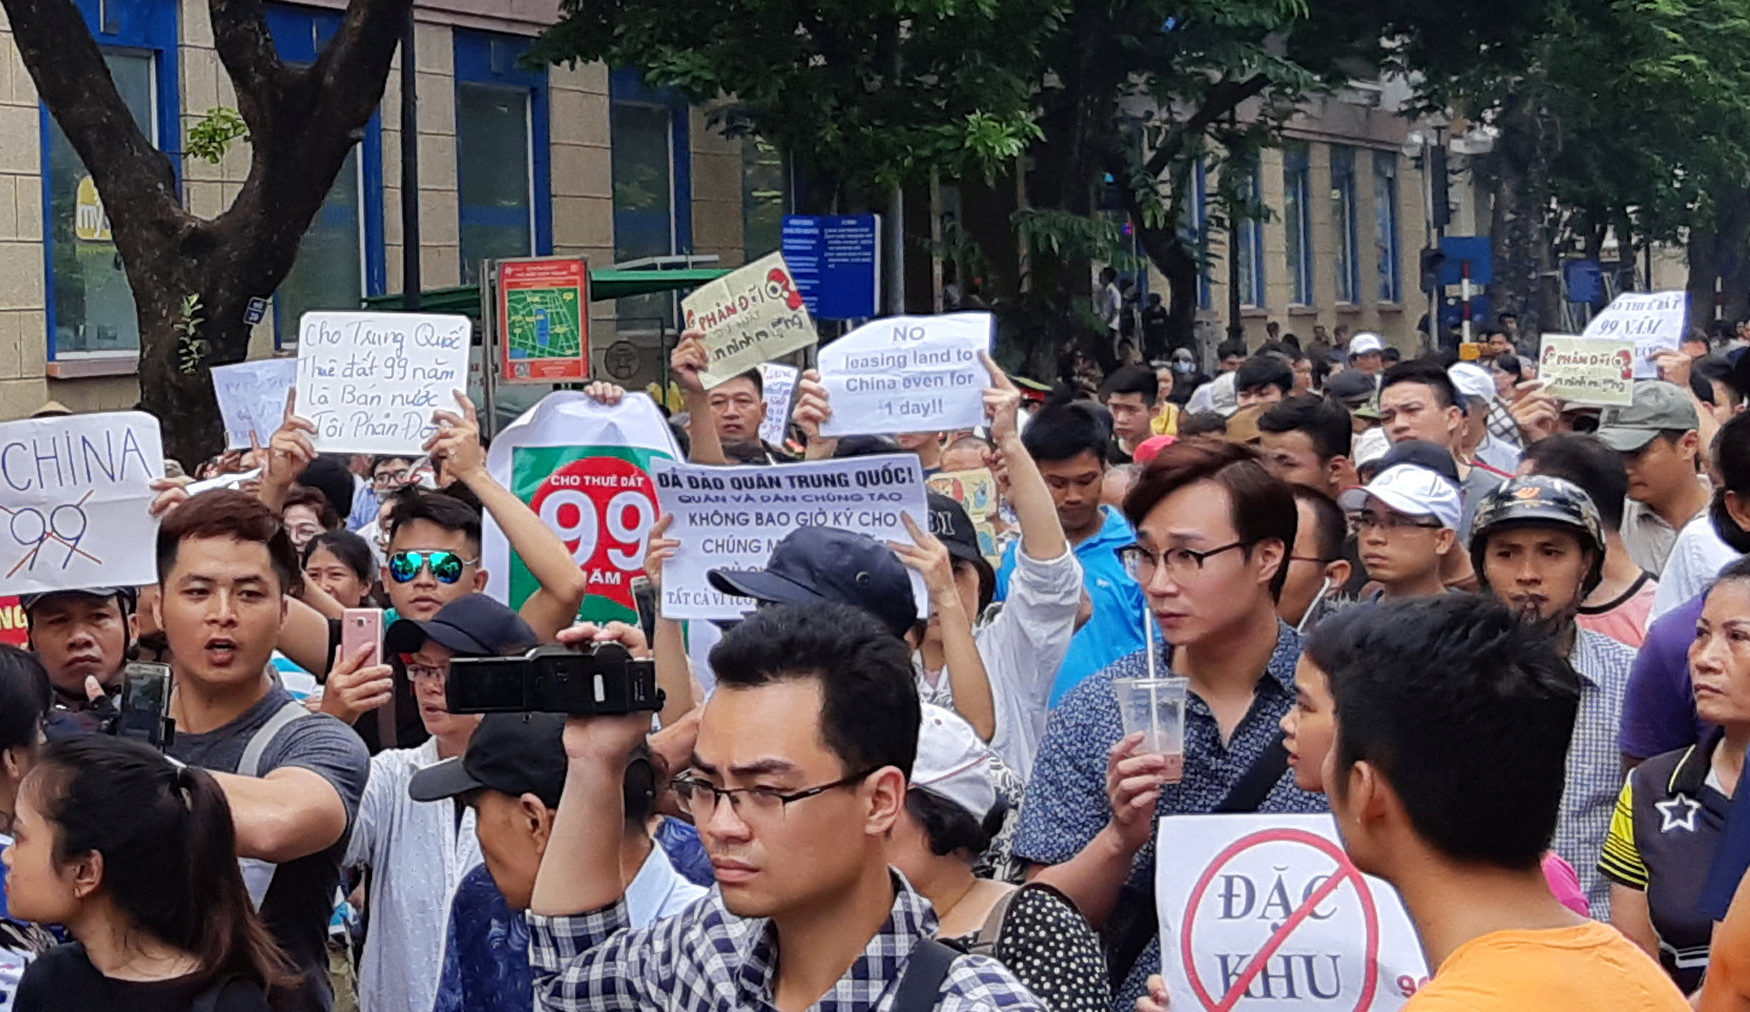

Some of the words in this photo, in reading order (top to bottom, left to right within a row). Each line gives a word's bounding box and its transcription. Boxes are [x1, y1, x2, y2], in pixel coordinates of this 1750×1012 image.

[698, 301, 738, 331] PHẢN
[1600, 318, 1619, 334] 99
[305, 319, 342, 347] Cho
[346, 319, 405, 358] Trung
[414, 322, 465, 350] Quốc
[893, 326, 925, 342] NO
[301, 355, 336, 379] Thuê
[342, 351, 379, 379] đất
[384, 356, 409, 381] 99
[412, 357, 455, 381] năm
[844, 352, 908, 371] leasing
[912, 348, 950, 366] land
[956, 348, 973, 363] to
[846, 375, 897, 393] China
[901, 376, 946, 390] even
[950, 371, 974, 386] for
[341, 383, 382, 407] Bán
[390, 383, 439, 408] nước
[884, 401, 893, 416] 1
[900, 399, 943, 418] day!!
[312, 409, 344, 438] Tôi
[350, 411, 399, 440] Phản
[551, 475, 580, 487] CHO
[584, 473, 617, 488] THUÊ
[621, 473, 644, 488] ĐẤT
[657, 467, 681, 488] ĐẢ
[687, 470, 725, 491] ĐẢO
[730, 472, 782, 491] QUÂN
[787, 472, 850, 490] TRUNG
[855, 461, 915, 486] QUỐC!
[677, 493, 727, 504] QUÂN
[760, 492, 797, 503] DÂN
[800, 491, 865, 503] CHÚNG
[867, 491, 903, 502] TAO
[689, 508, 750, 528] KHÔNG
[755, 511, 790, 528] BAO
[796, 508, 828, 528] GIỜ
[832, 507, 853, 527] KÝ
[858, 510, 897, 528] CHO
[9, 503, 87, 571] 99
[539, 489, 656, 571] 99
[702, 535, 762, 554] CHÚNG
[585, 567, 621, 585] ĂM
[667, 584, 691, 606] TẤT
[693, 587, 711, 606] CẢ
[1217, 865, 1339, 933] ĐẶC
[1214, 953, 1342, 1000] KHU
